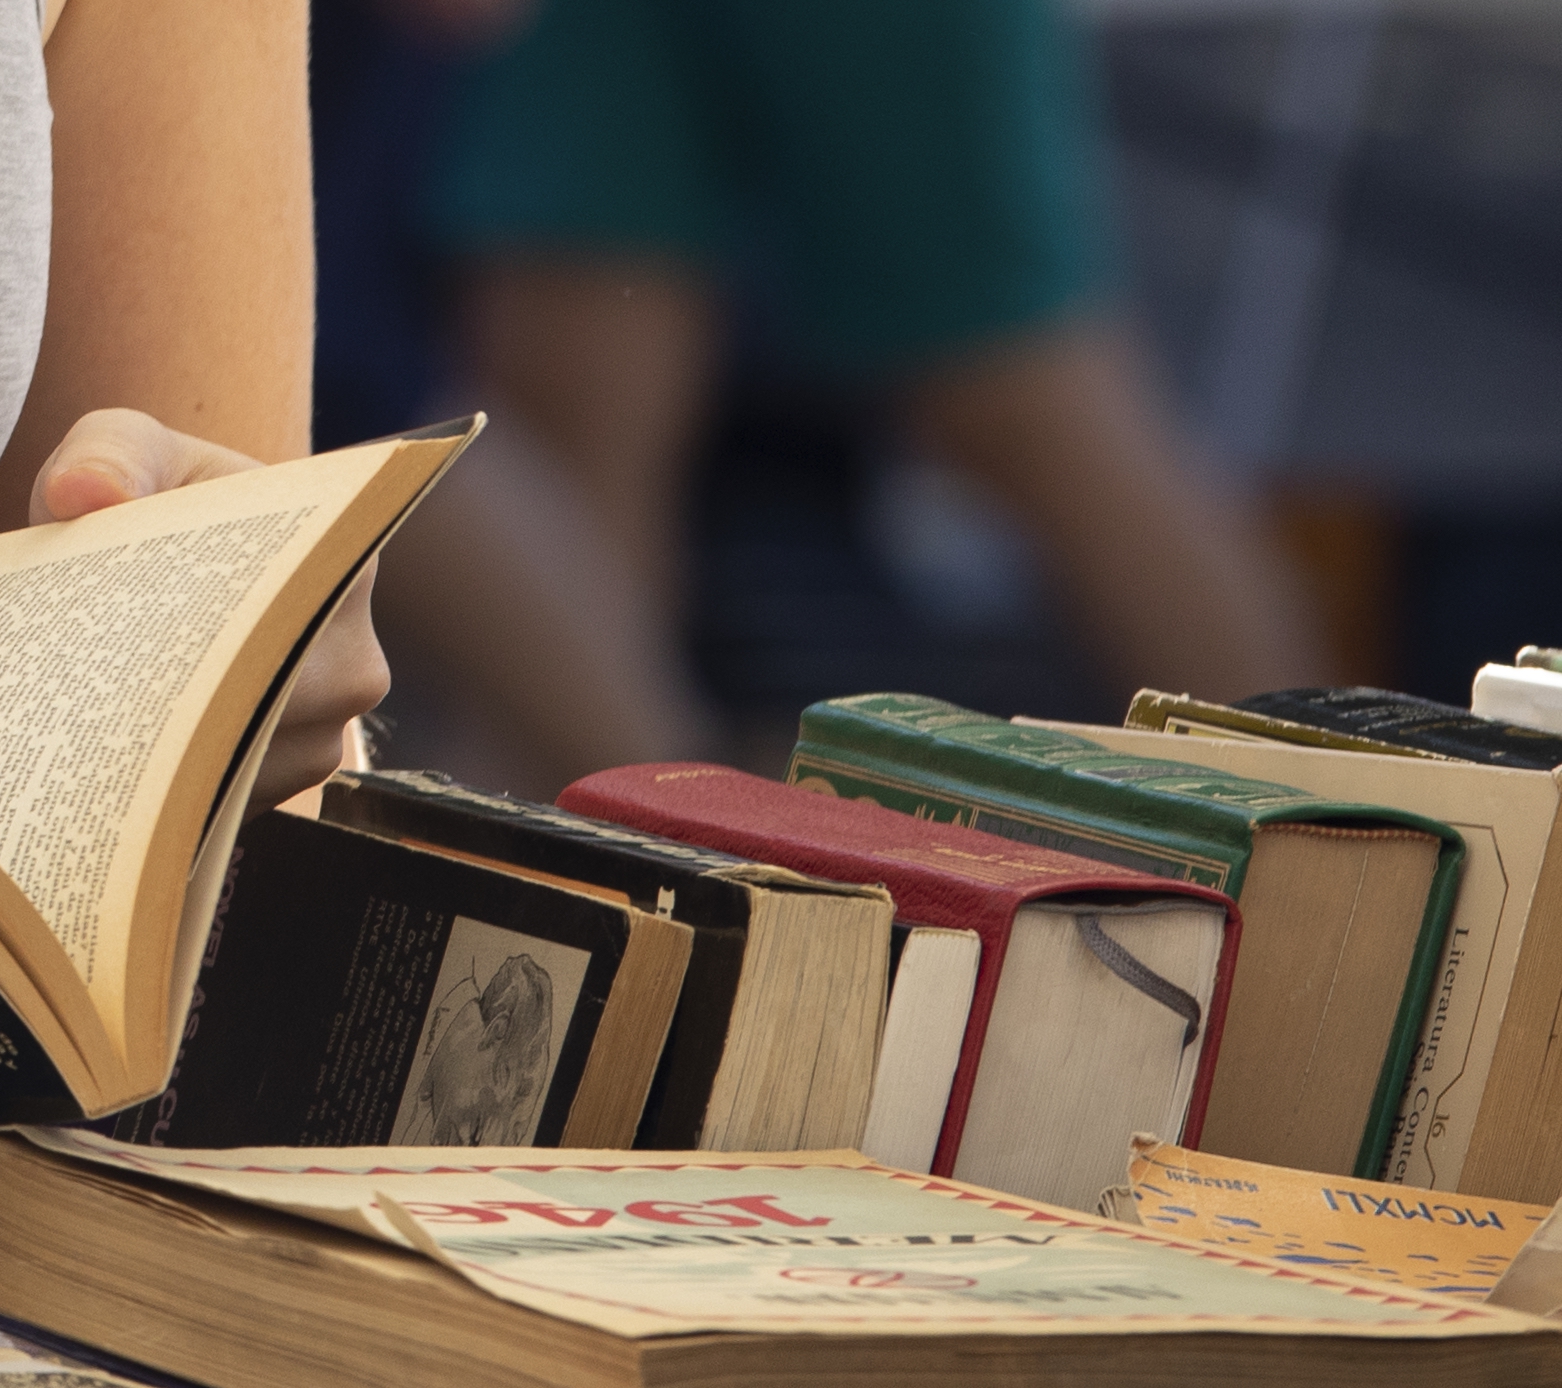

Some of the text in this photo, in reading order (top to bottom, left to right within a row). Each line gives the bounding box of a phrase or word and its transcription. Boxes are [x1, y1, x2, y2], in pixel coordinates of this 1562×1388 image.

[1422, 928, 1469, 1072] Literatura
[1432, 1114, 1450, 1137] 16
[370, 1194, 831, 1228] 1946
[1320, 1187, 1505, 1230] MCMXLI
